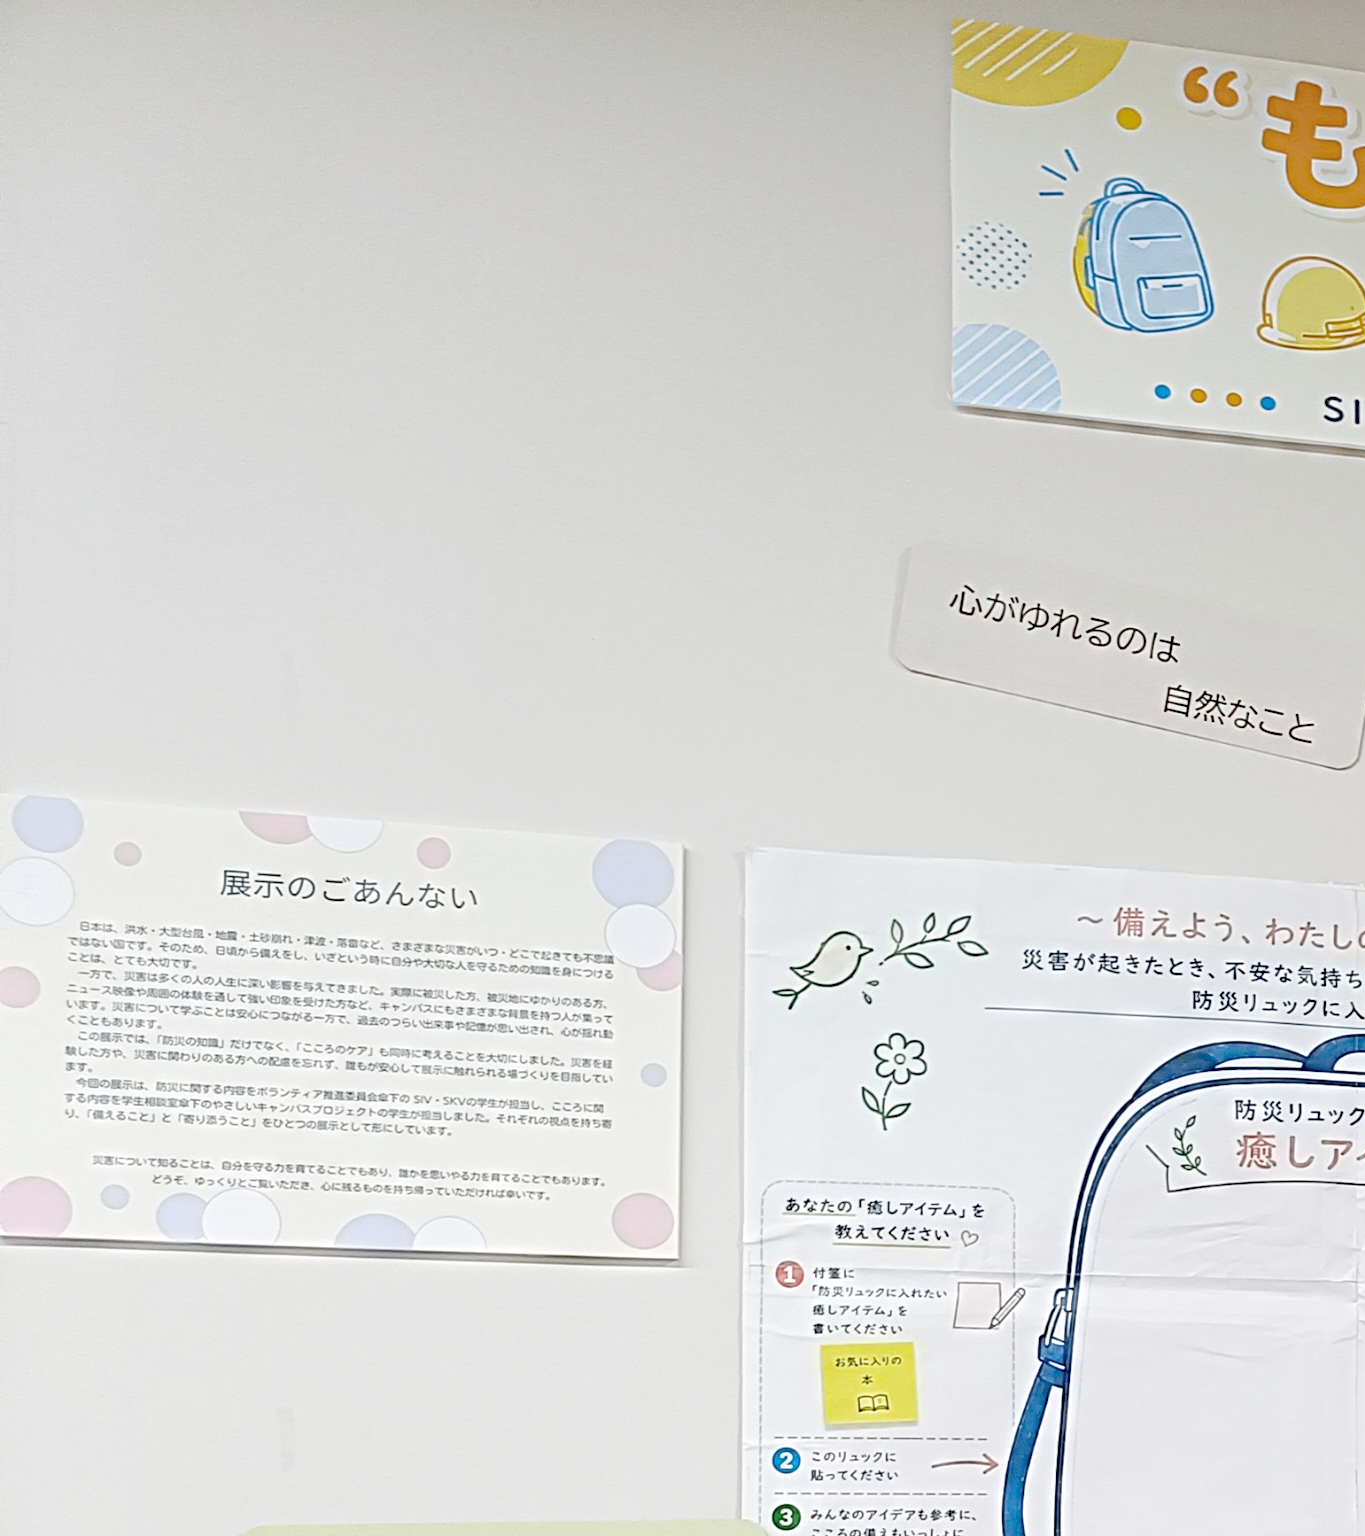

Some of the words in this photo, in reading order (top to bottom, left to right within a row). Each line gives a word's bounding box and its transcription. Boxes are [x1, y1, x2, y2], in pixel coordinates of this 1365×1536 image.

[949, 584, 1181, 663] 心がゆれるのは
[1162, 685, 1315, 744] 自然なこと
[220, 869, 478, 910] 展示のごあんない
[67, 952, 198, 970] ことは、とても大切です。
[66, 1014, 163, 1031] くこともあります。
[64, 1061, 94, 1073] ます。
[784, 1195, 985, 1220] あなたの「癒しアイテム」を
[834, 1222, 950, 1244] 教えてください
[811, 1283, 948, 1301] 「防災リュックに入れたい
[812, 1303, 908, 1319] 癒しアイテム」を
[812, 1321, 903, 1336] 書いてください
[834, 1354, 903, 1368] お気に入りの
[861, 1373, 875, 1386] 本
[810, 1449, 897, 1465] このリュックに
[810, 1467, 899, 1483] 貼ってください
[810, 1507, 979, 1523] みんなのアイデアも参考に、
